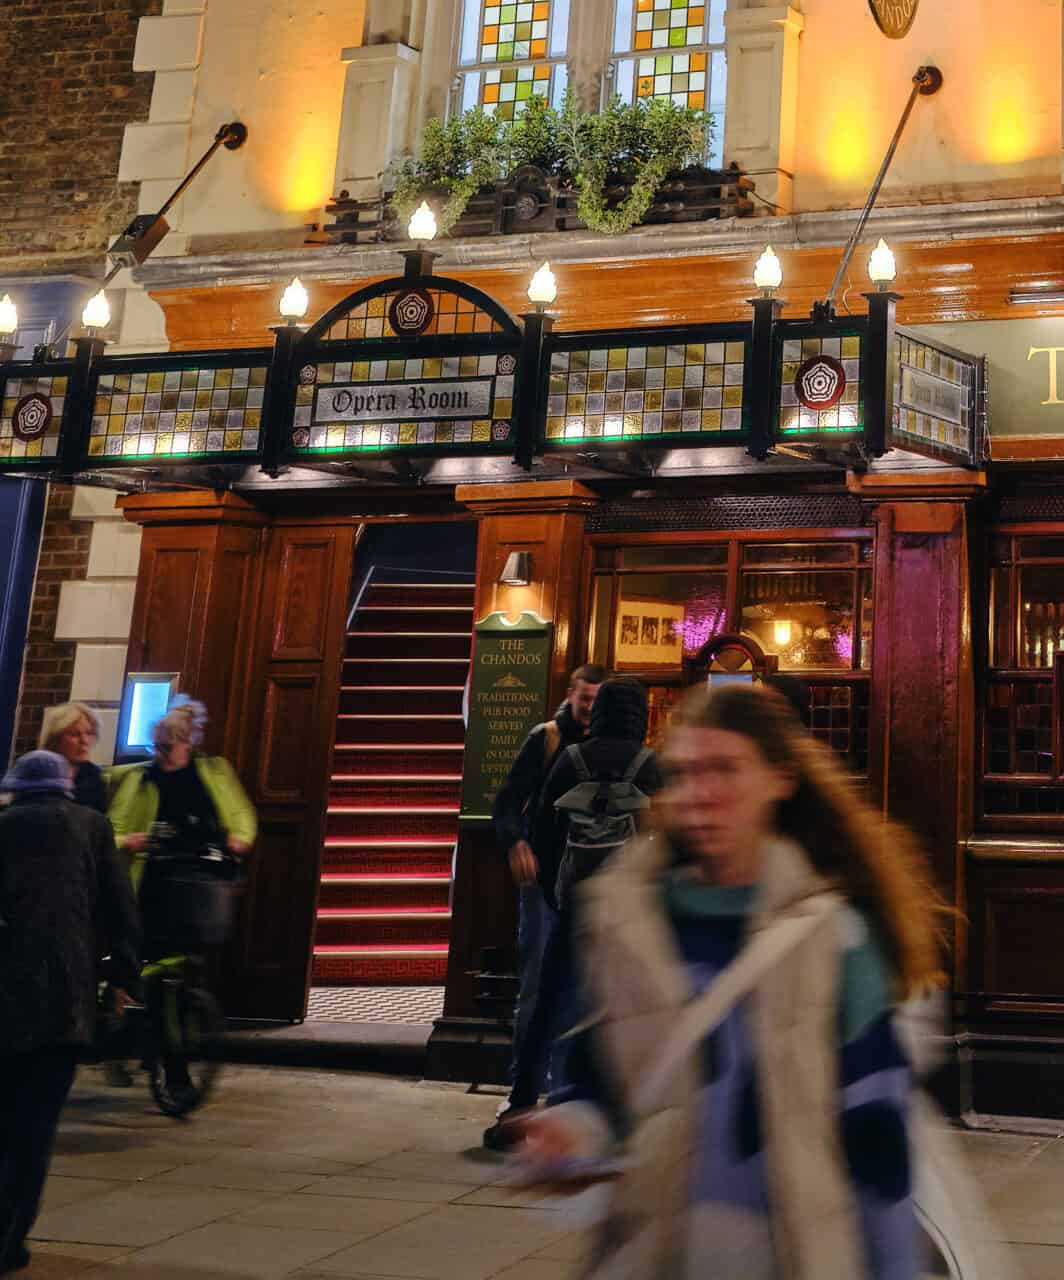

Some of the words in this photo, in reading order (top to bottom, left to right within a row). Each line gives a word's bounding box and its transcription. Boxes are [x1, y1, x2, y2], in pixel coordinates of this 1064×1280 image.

[332, 390, 397, 415] Opera
[408, 386, 469, 410] Room
[500, 639, 525, 651] THE
[481, 653, 542, 665] CHANDOS
[478, 692, 539, 703] TRADITIONAL
[503, 706, 531, 717] FOOD
[488, 720, 524, 730] SERVED
[491, 735, 519, 745] DAILY
